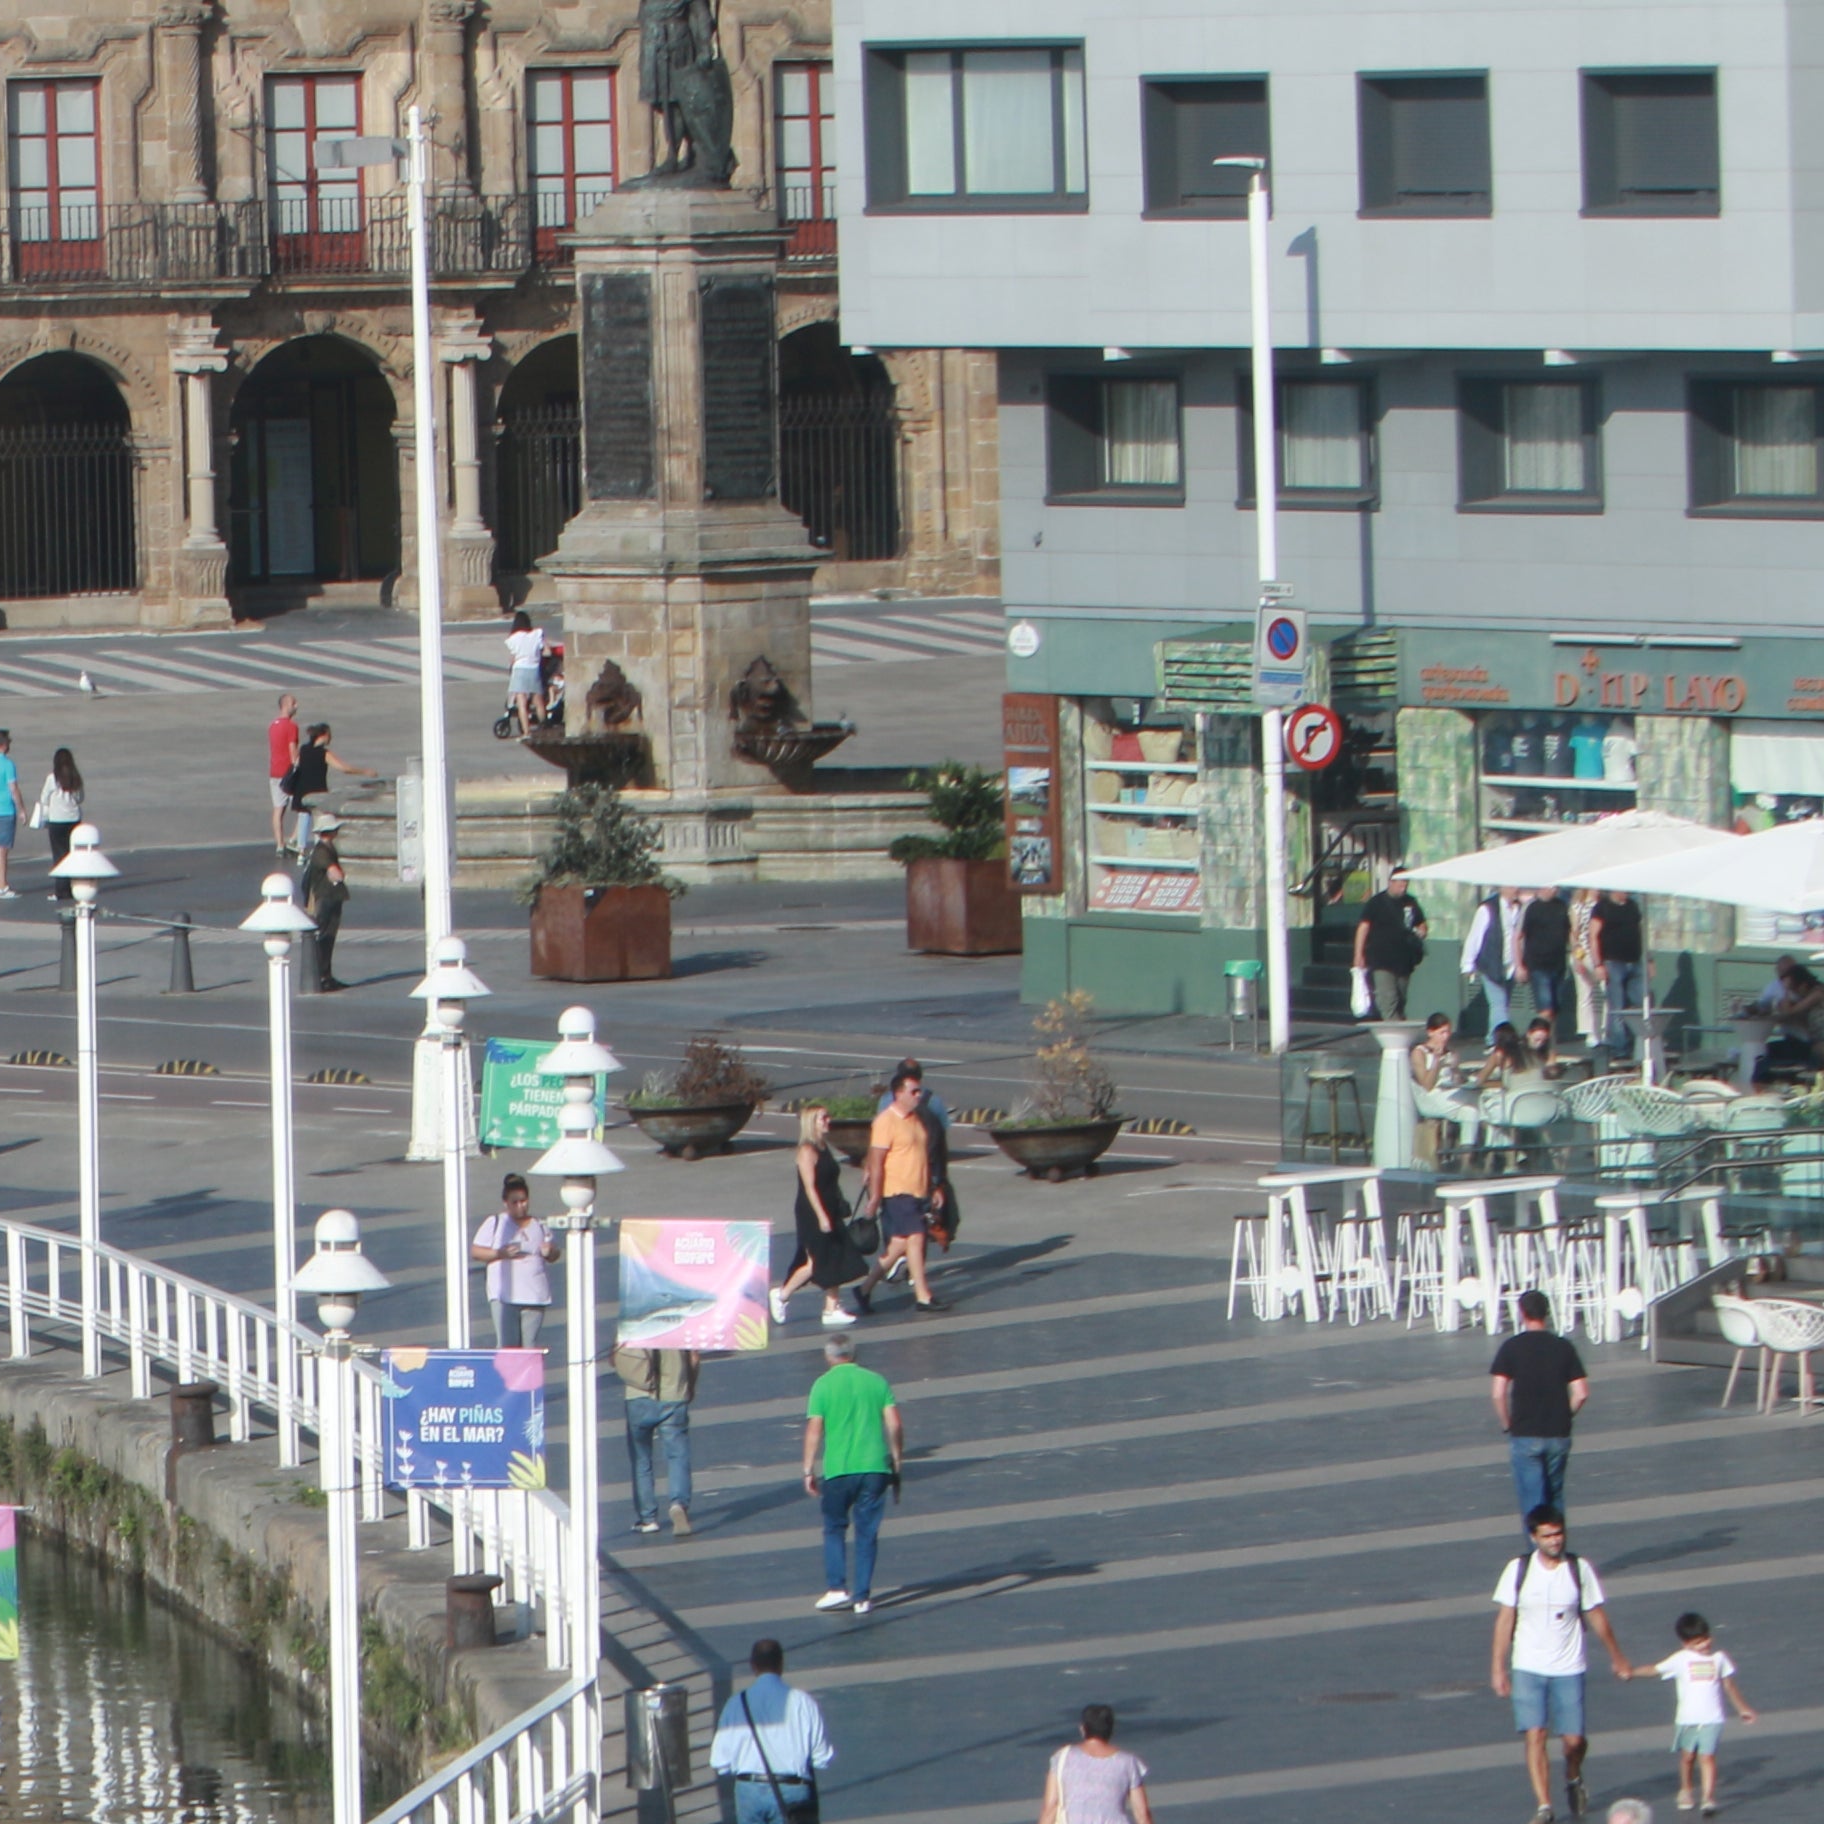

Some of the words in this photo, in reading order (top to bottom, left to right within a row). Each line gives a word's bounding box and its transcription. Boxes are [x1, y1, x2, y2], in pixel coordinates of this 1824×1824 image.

[510, 1073, 540, 1089] ¿LOS
[523, 1087, 565, 1104] TIENEN
[420, 1406, 456, 1426] ¿HAY
[459, 1403, 504, 1424] PIÑAS
[420, 1427, 439, 1443] EN
[443, 1427, 461, 1443] EL
[463, 1426, 505, 1443] MAR?
